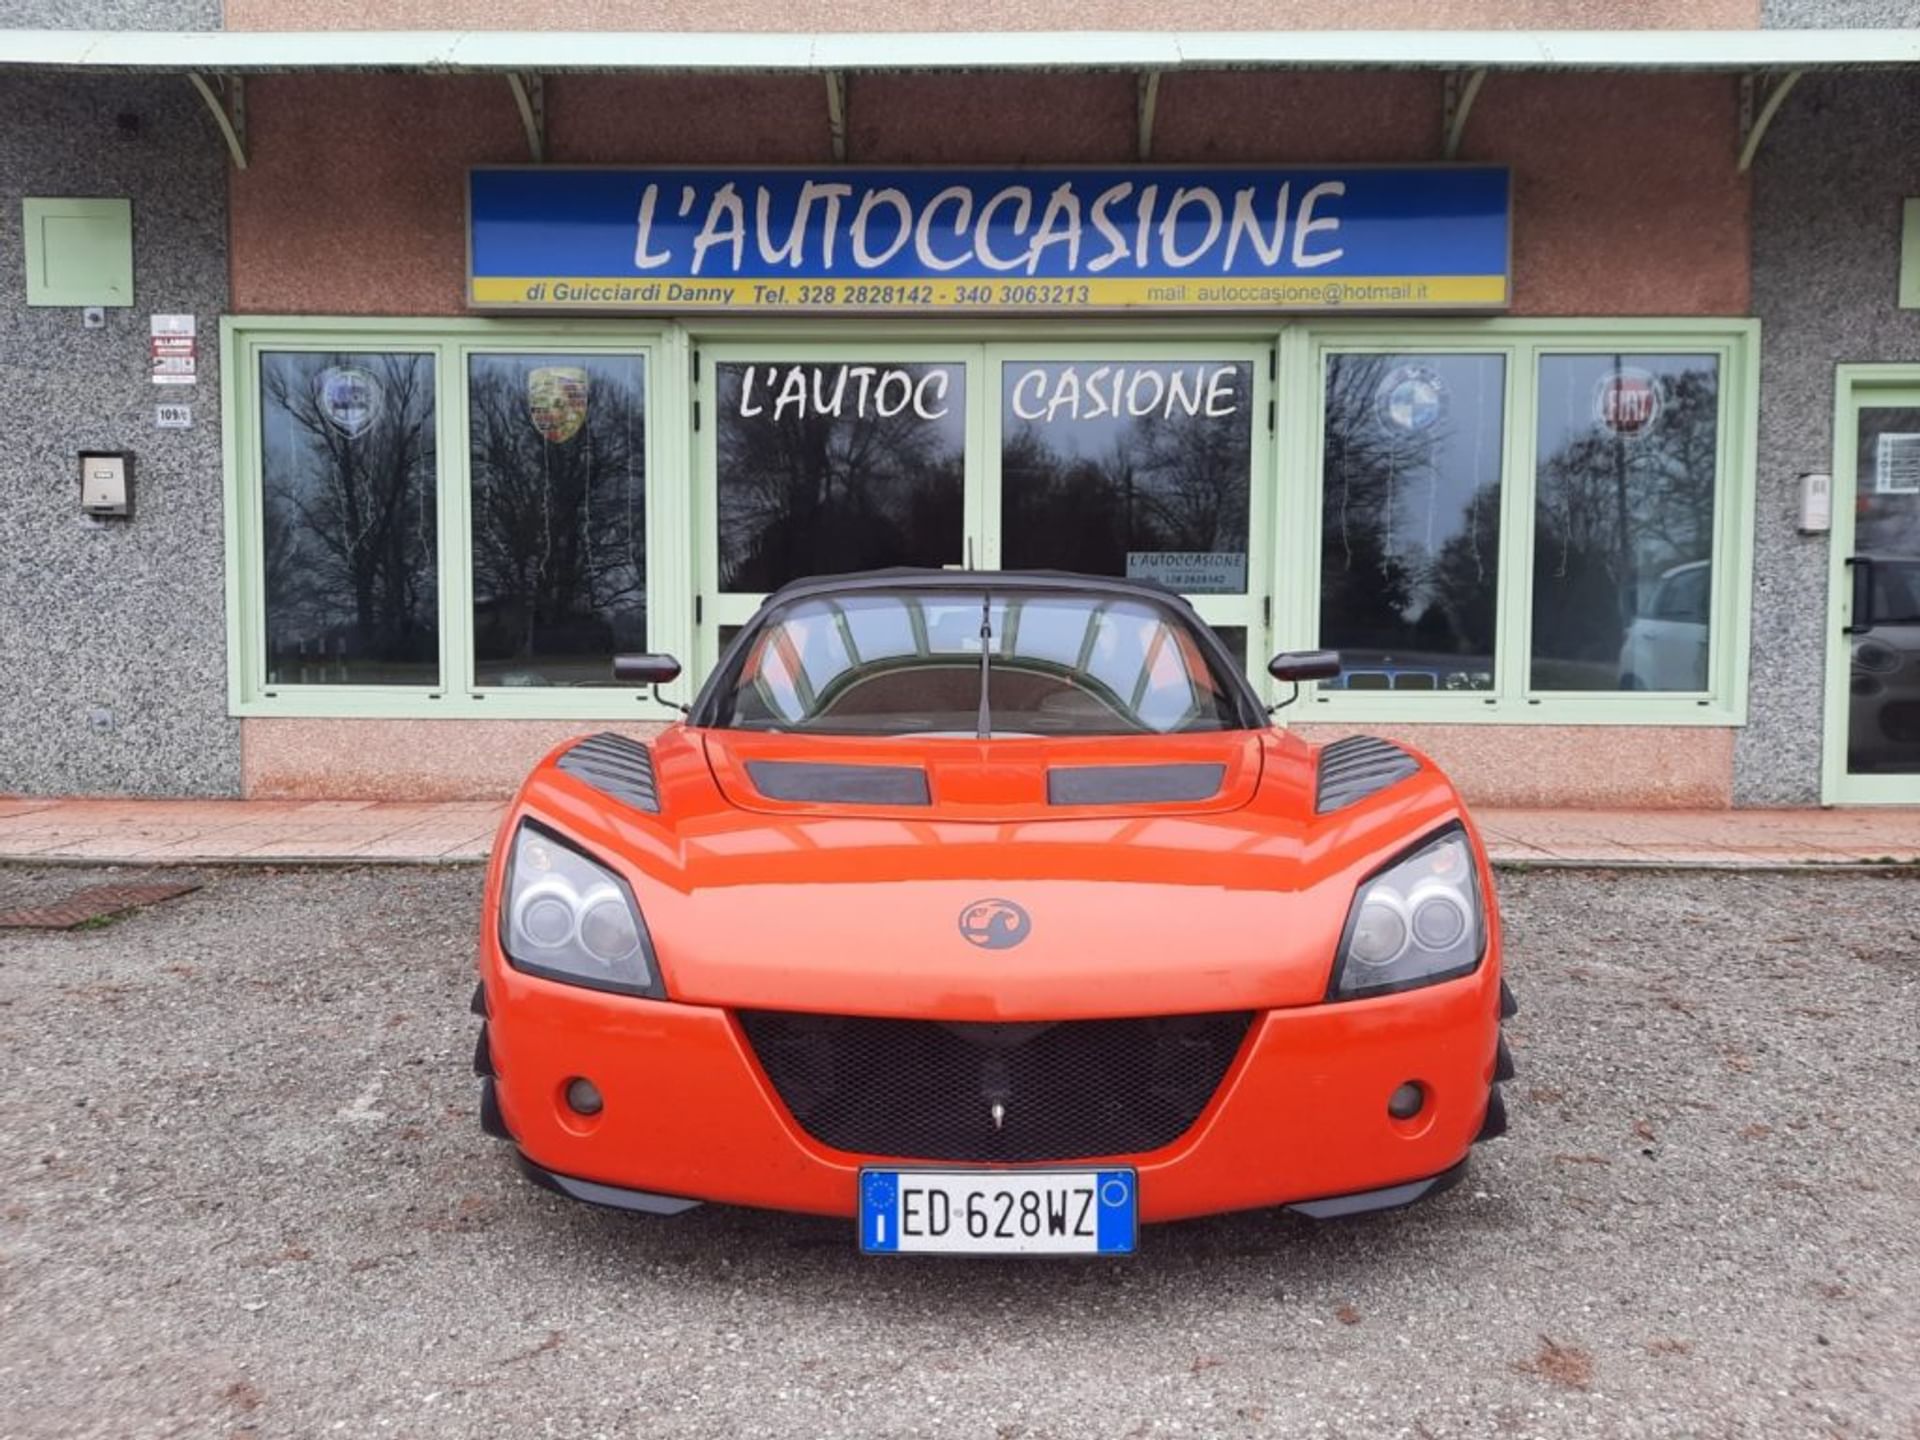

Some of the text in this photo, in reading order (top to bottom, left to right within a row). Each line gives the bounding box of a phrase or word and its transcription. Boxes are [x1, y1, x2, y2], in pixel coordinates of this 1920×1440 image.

[634, 181, 1346, 275] L'AUTOCCASIONE
[526, 283, 545, 301] di
[553, 283, 661, 301] Guicciardi
[666, 284, 735, 305] Danny
[753, 285, 790, 304] Tel.
[798, 286, 836, 304] 328
[843, 285, 933, 304] 2828142
[954, 286, 993, 304] 340
[999, 285, 1090, 304] 3063213
[739, 365, 1238, 421] L'AUTOC CASIONE
[1130, 554, 1242, 568] L'AUTOCCASIONE
[903, 1189, 1094, 1238] ED 628WZ
